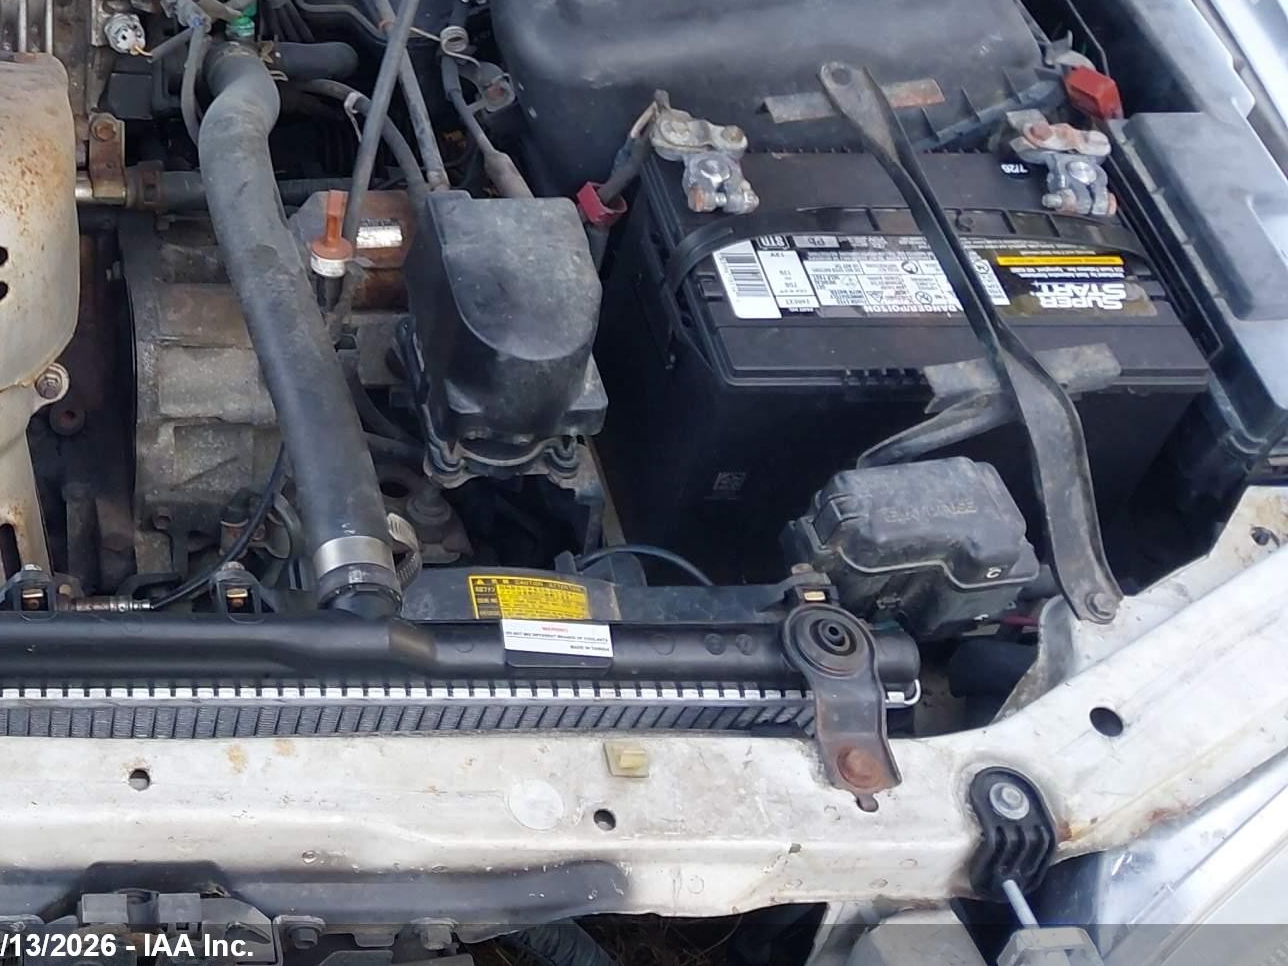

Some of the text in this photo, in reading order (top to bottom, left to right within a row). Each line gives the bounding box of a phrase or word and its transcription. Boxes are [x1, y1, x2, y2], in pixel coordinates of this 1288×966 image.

[807, 237, 826, 247] Pb
[1037, 282, 1127, 298] START
[1039, 296, 1124, 310] SUPER
